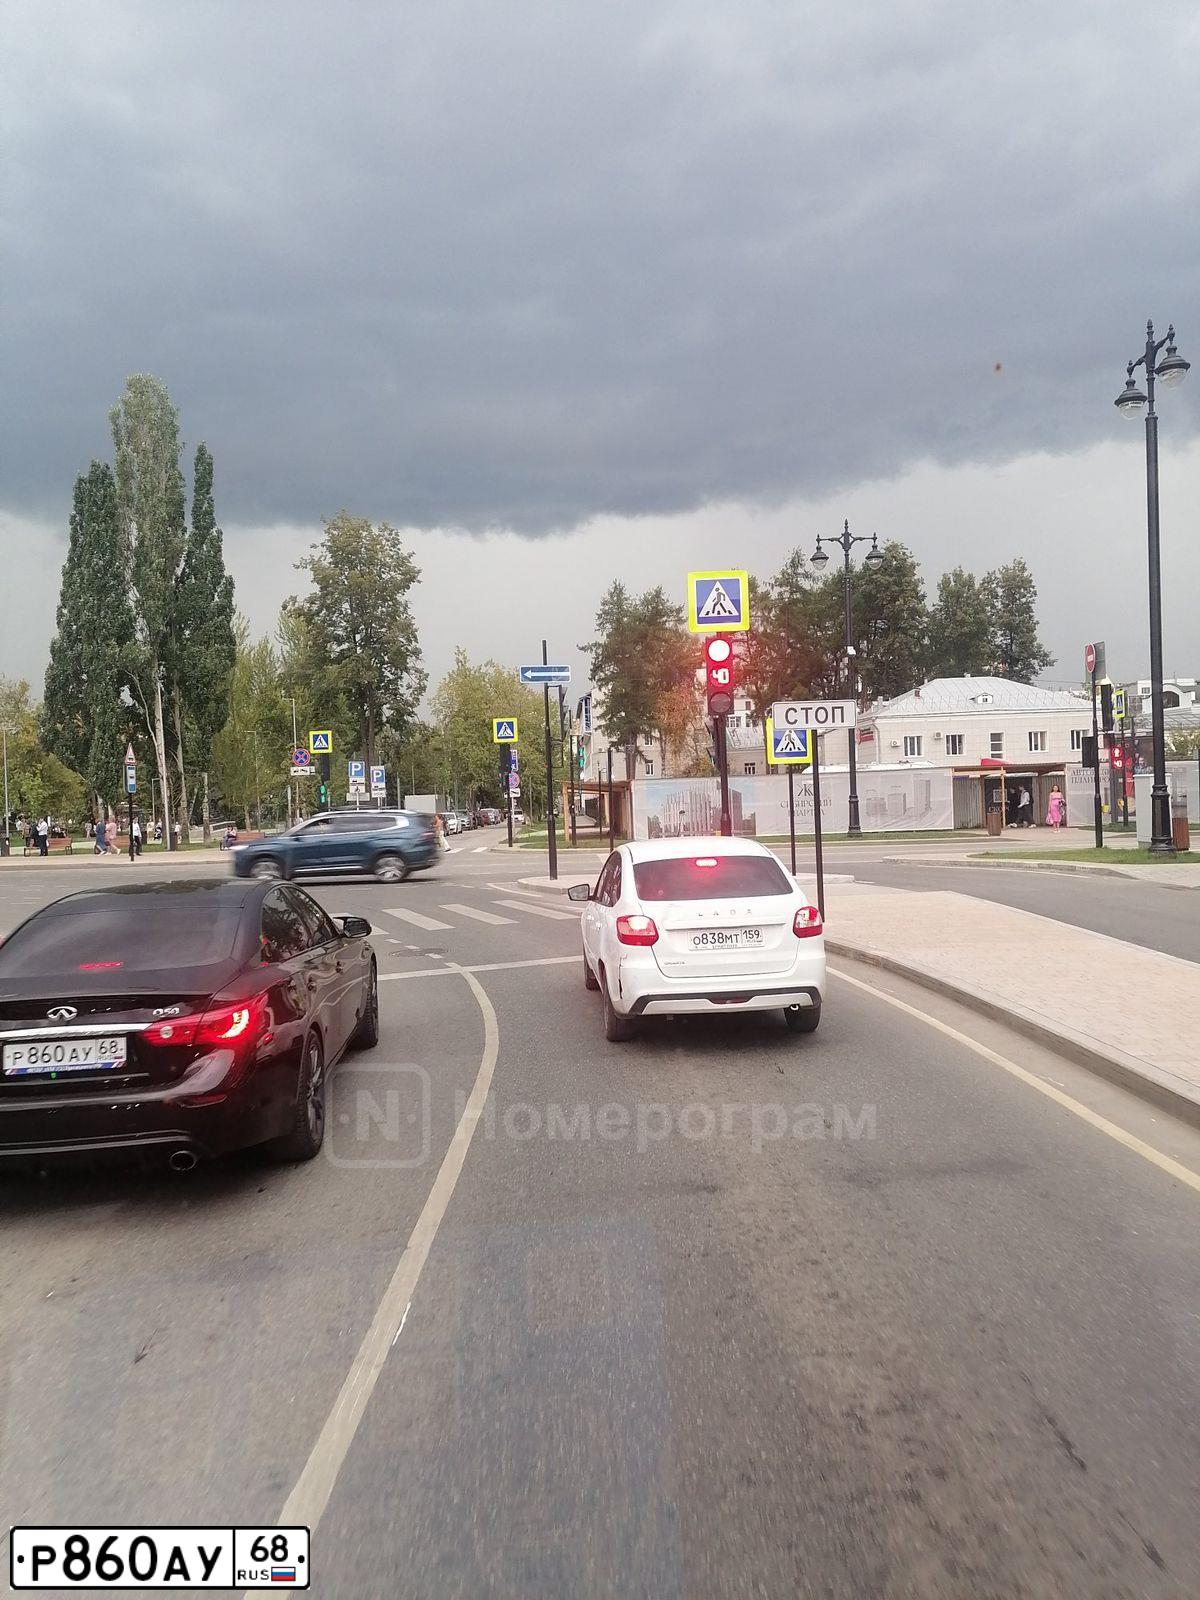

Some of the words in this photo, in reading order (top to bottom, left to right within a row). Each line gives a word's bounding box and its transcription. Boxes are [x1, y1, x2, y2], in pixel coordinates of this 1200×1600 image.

[712, 668, 729, 684] 40
[785, 705, 845, 725] СТОП
[693, 932, 740, 946] О838МТ
[742, 929, 760, 940] 159
[12, 1045, 92, 1066] Р860АУ
[99, 1040, 118, 1055] 68
